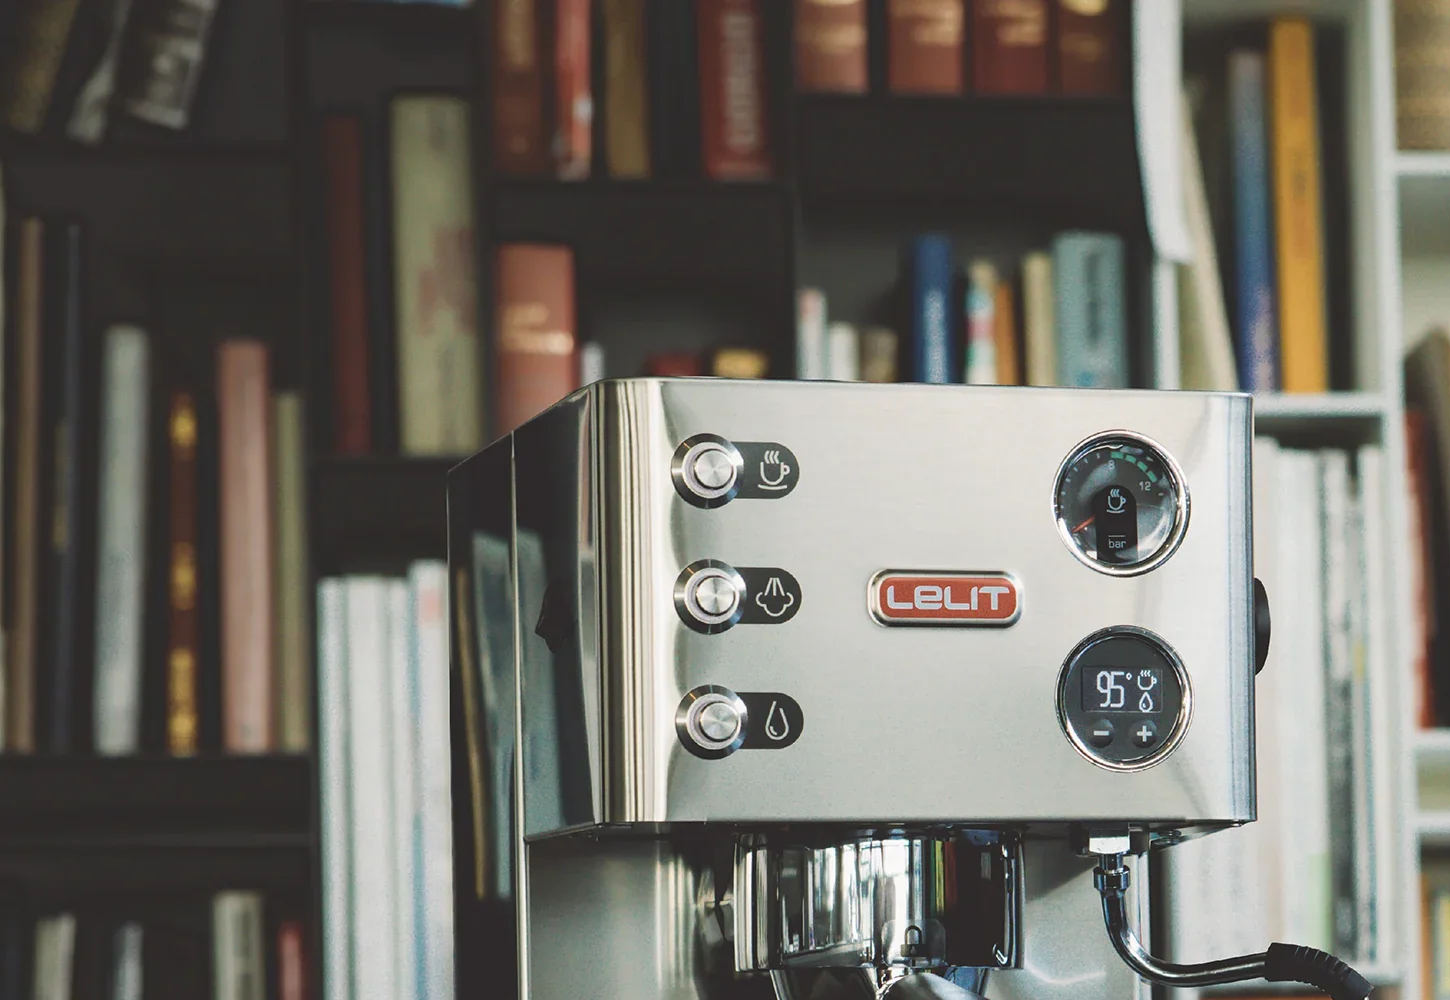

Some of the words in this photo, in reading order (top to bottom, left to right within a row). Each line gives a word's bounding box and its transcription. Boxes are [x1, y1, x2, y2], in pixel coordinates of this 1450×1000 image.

[1108, 460, 1115, 470] 8
[1139, 481, 1151, 491] 12
[1108, 539, 1127, 549] bar
